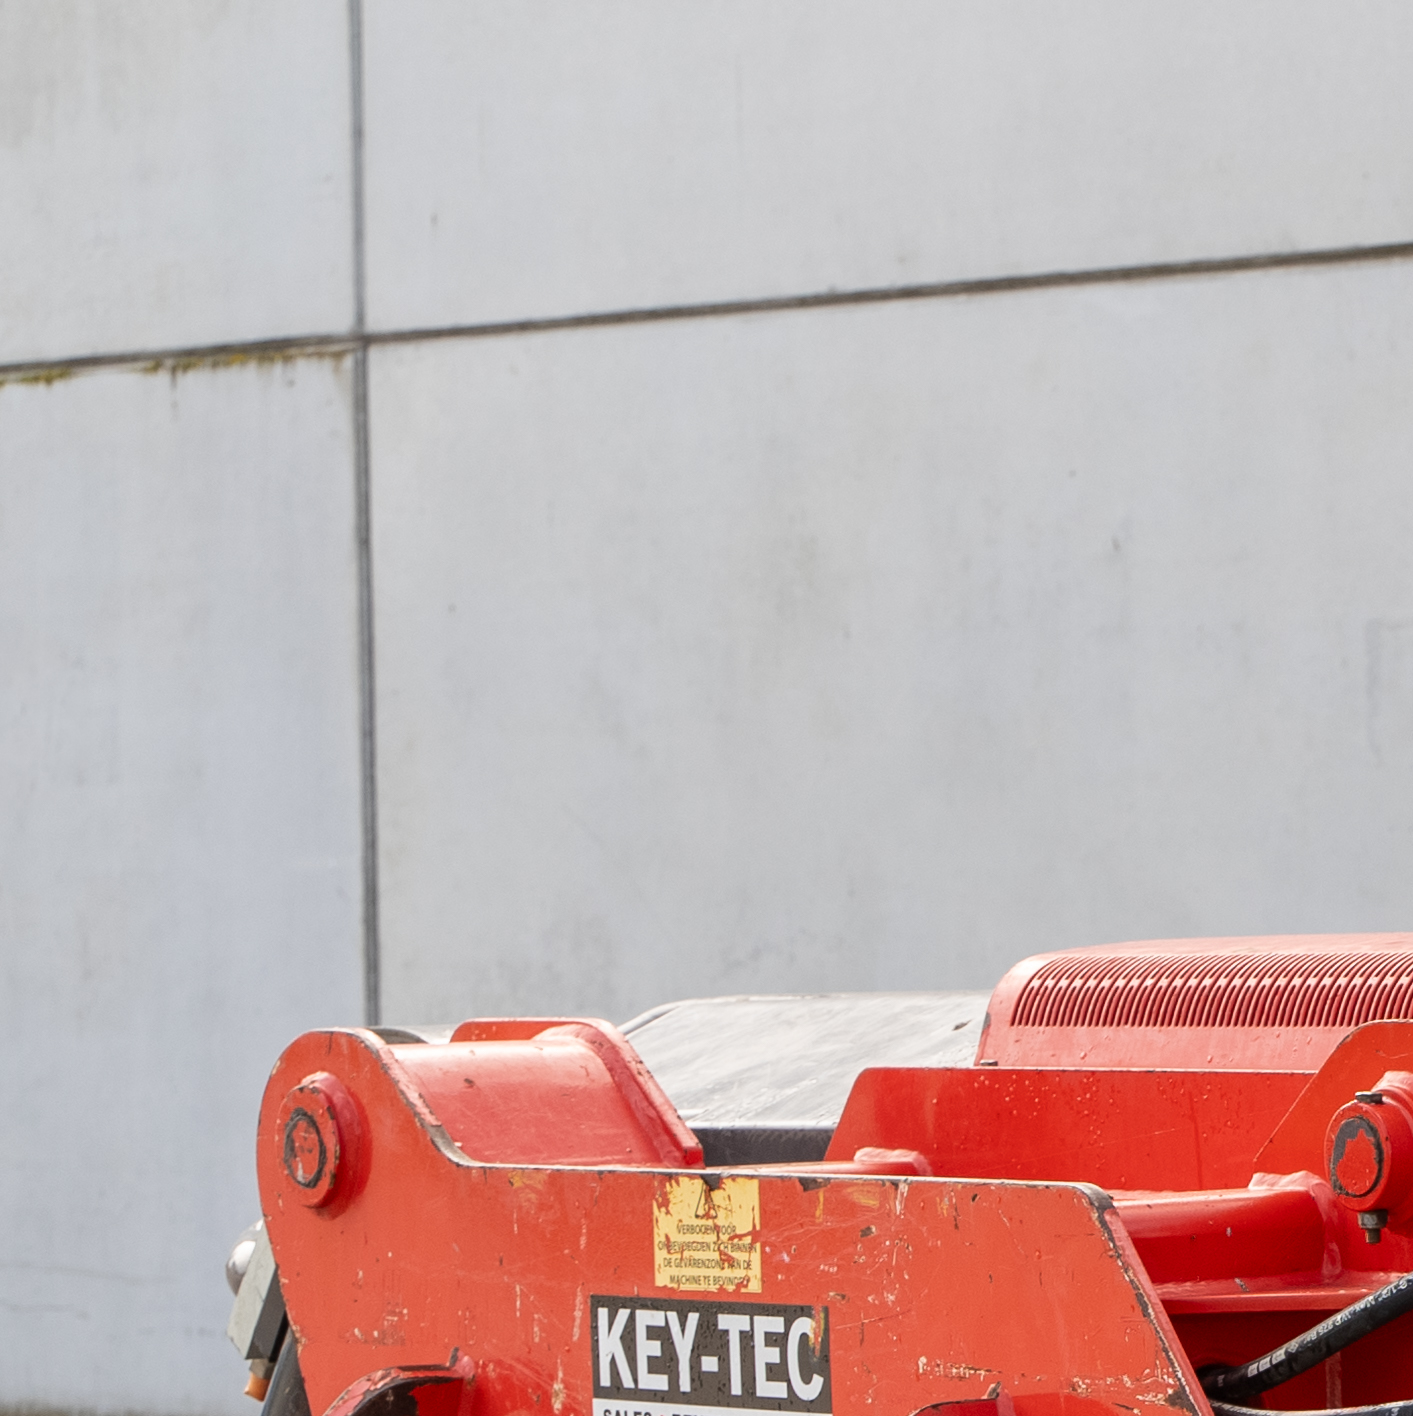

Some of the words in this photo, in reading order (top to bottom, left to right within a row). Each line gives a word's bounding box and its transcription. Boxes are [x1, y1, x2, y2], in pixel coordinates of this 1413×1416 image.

[663, 1257, 673, 1268] DE
[669, 1274, 701, 1286] MACHINE
[597, 1307, 825, 1402] KEY-TEC
